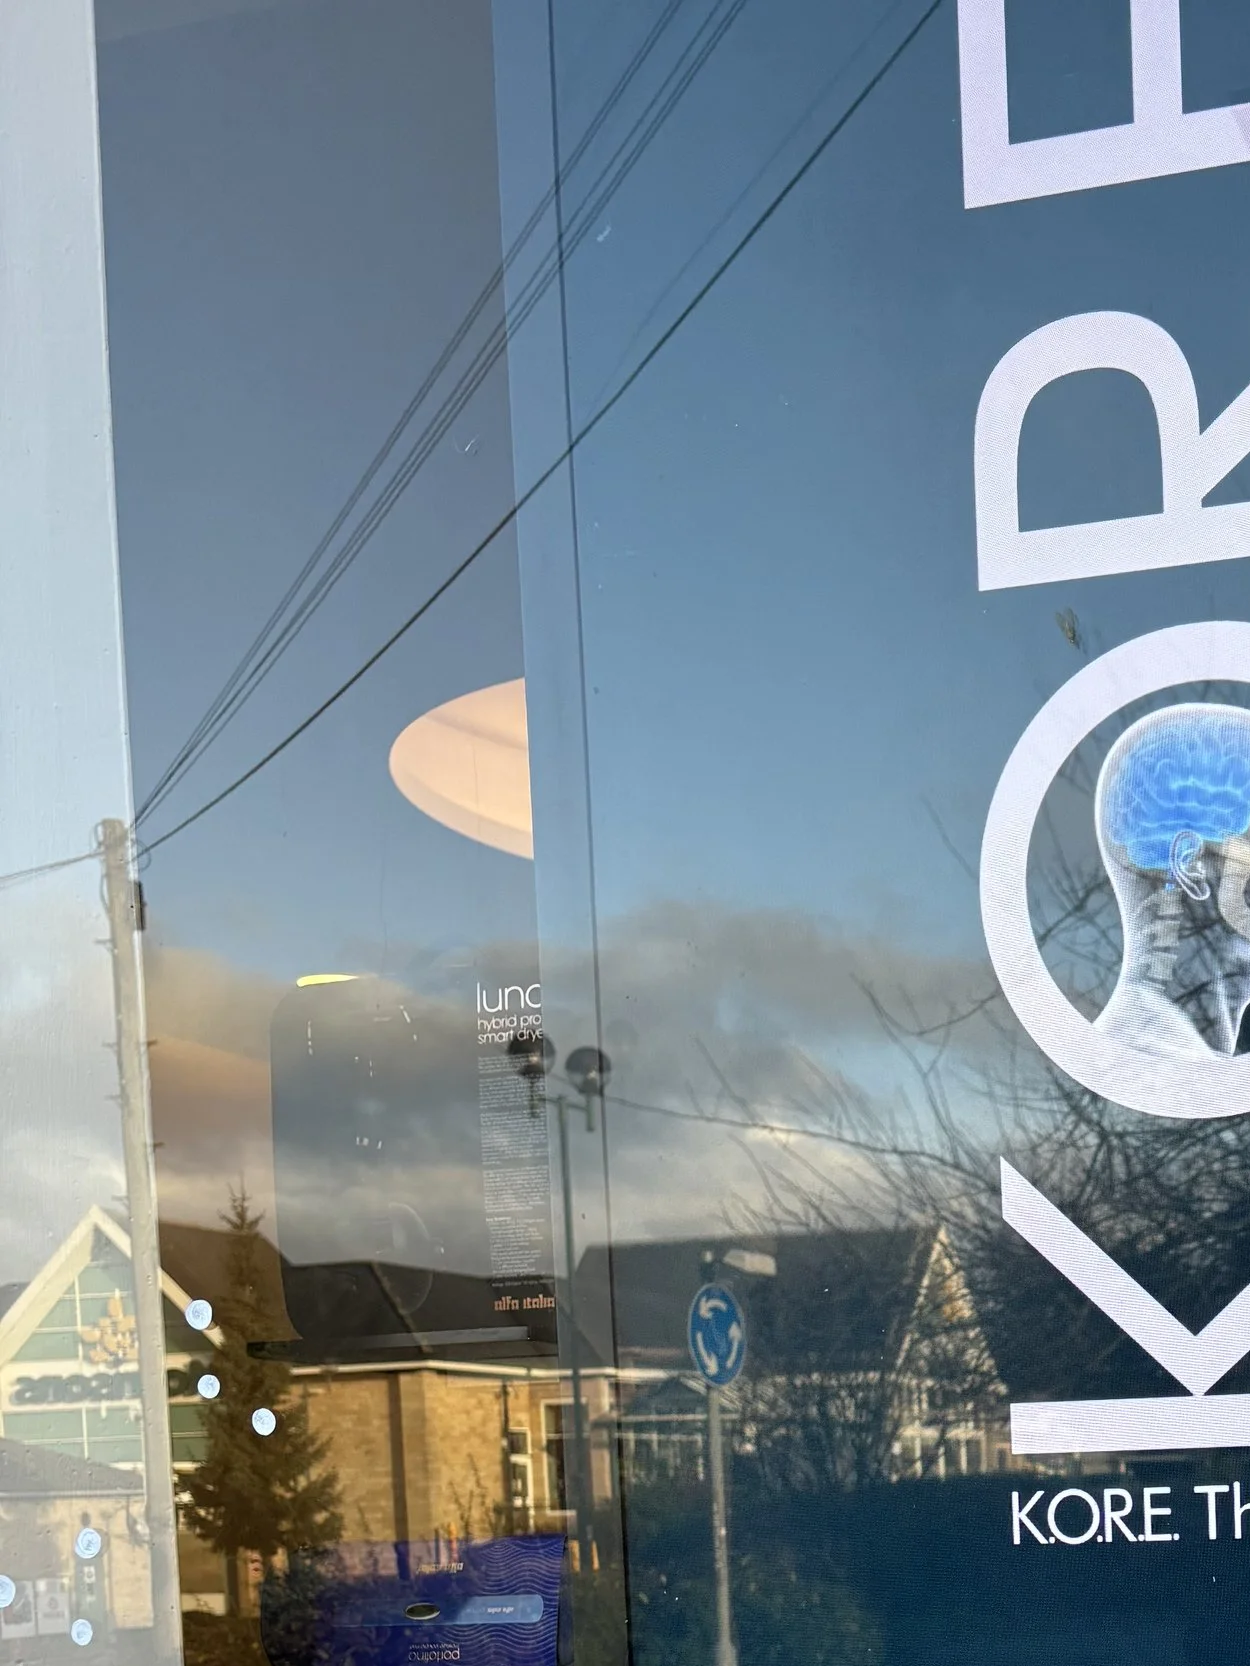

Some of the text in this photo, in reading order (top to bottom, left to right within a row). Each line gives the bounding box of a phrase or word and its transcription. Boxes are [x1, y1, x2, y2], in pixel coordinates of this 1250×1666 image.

[477, 1014, 517, 1031] hybrid
[478, 1029, 514, 1044] smart
[408, 1647, 460, 1663] portofino
